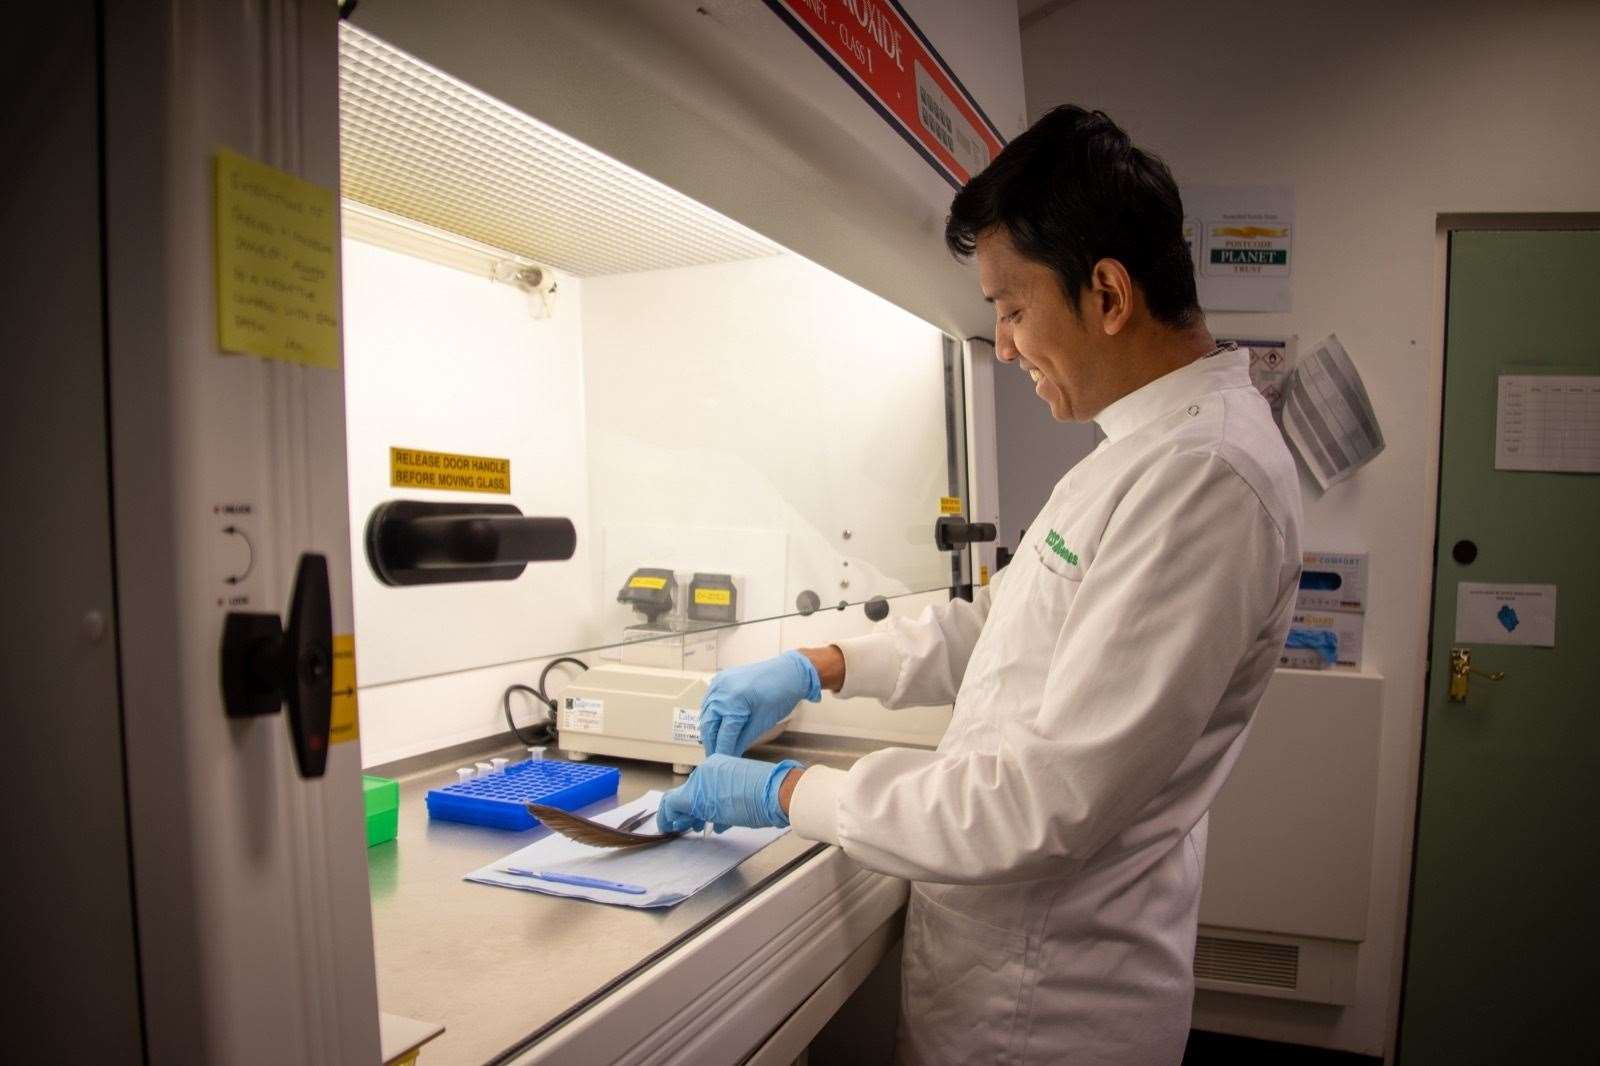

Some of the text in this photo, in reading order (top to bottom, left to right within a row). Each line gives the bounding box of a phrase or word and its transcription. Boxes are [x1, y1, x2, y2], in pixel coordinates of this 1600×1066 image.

[839, 24, 866, 65] CLASS
[1221, 251, 1276, 263] PLANET
[1234, 265, 1262, 273] TRUST
[395, 452, 506, 473] RELEASE DOOR HANDLE
[395, 471, 505, 490] BEFORE MOVING GLASS
[1320, 557, 1360, 565] COMFORT
